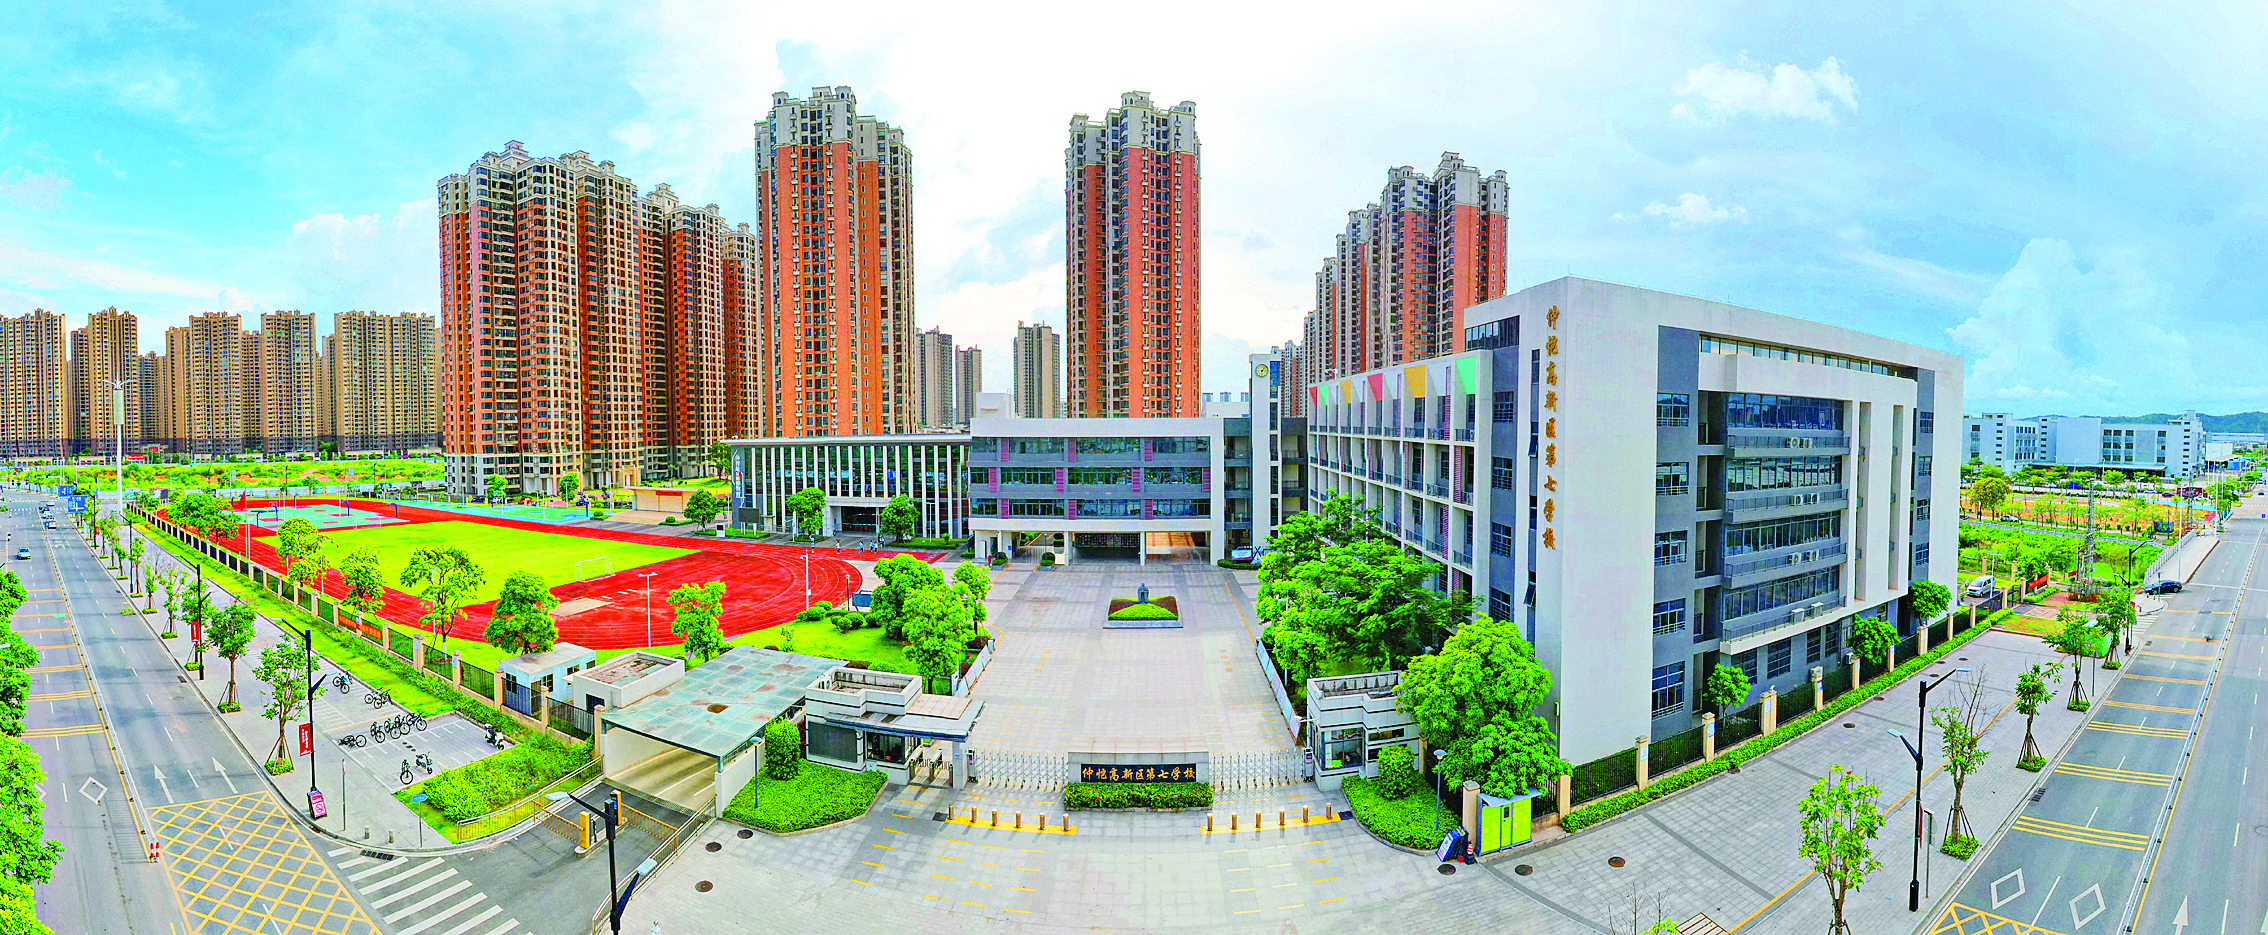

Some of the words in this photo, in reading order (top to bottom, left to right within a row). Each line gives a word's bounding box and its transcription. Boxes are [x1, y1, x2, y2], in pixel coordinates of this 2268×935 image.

[1542, 305, 1560, 550] 仲恺高新区第七学校
[1081, 766, 1196, 781] 仲恺高新区第七学校
